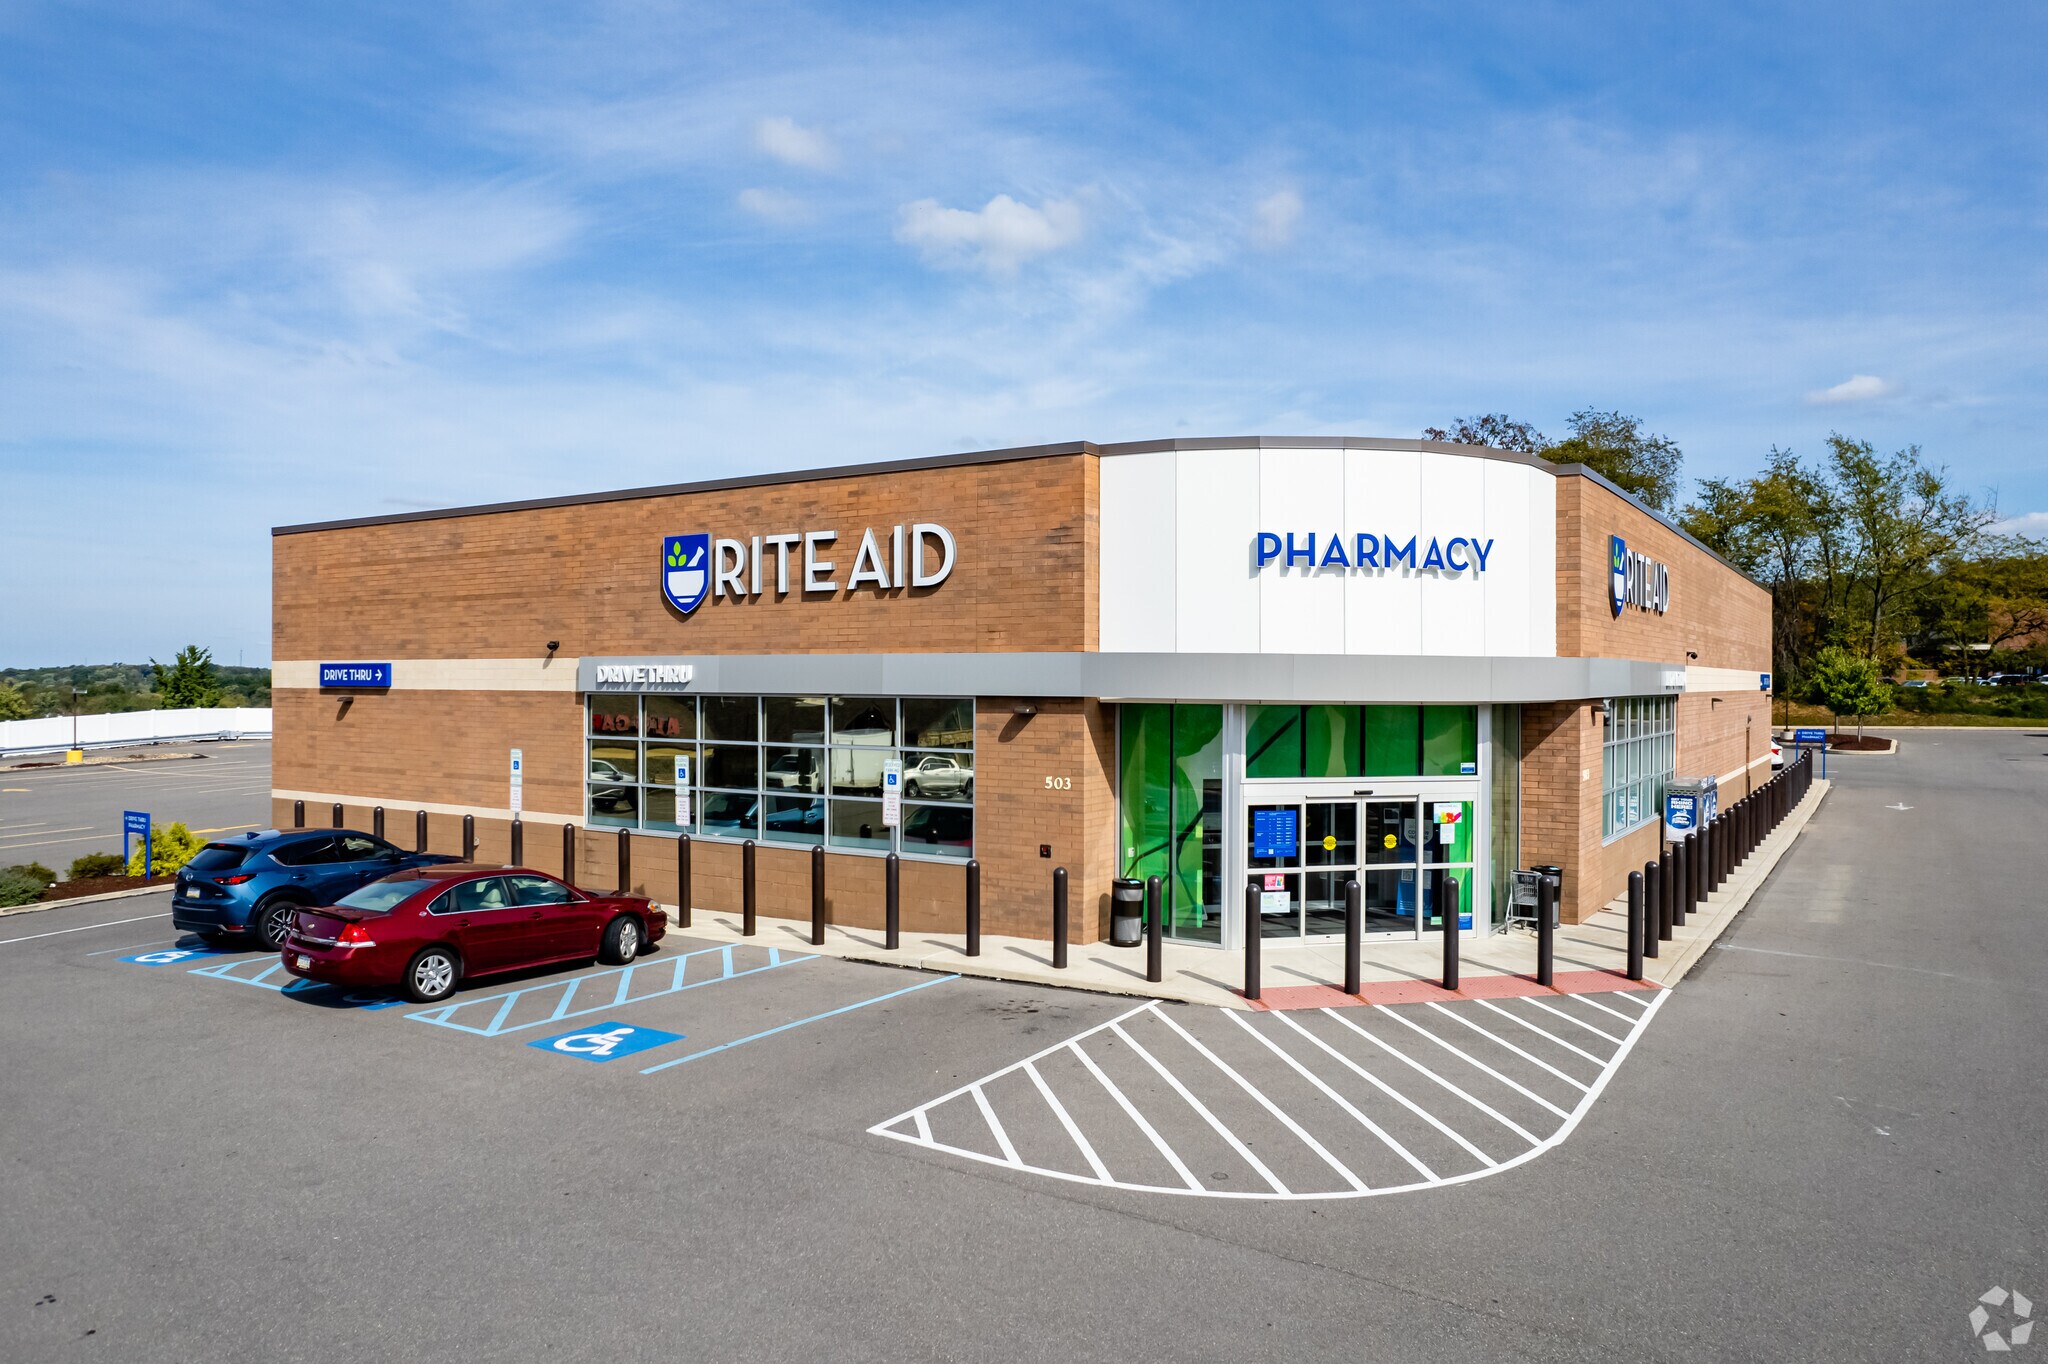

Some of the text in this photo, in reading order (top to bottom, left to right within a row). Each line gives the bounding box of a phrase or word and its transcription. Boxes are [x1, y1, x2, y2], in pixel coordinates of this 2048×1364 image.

[715, 523, 957, 597] RITE AID
[1257, 531, 1495, 573] PHARMACY
[1626, 547, 1670, 613] RITE AID
[324, 669, 372, 681] DRIVE THRU
[597, 665, 694, 683] DRIVE THRU
[1044, 775, 1072, 790] 503
